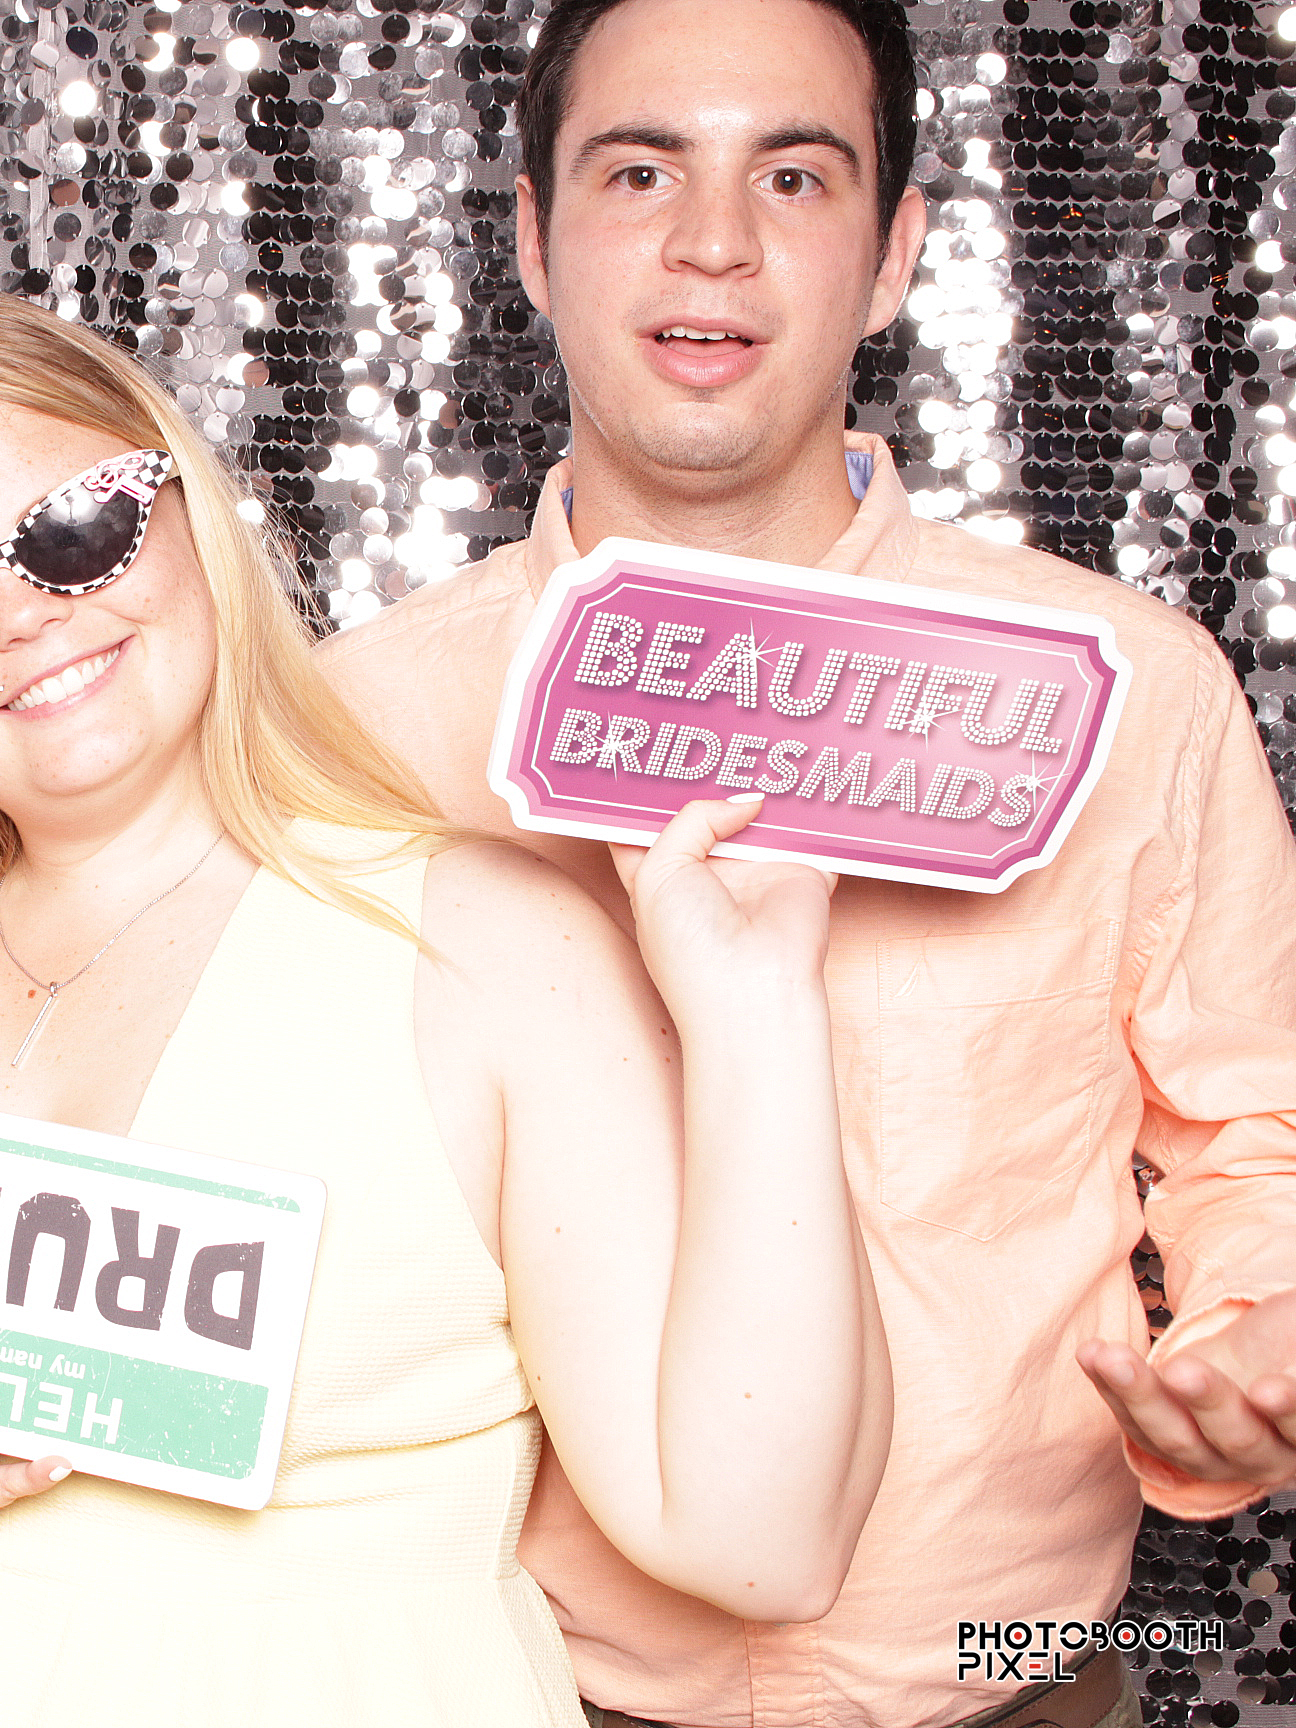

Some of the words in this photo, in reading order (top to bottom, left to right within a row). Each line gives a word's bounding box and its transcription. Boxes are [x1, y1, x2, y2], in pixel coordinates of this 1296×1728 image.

[574, 611, 1065, 755] BEAUTIFUL
[549, 707, 1034, 828] BRIDESMAIDS
[49, 1354, 86, 1380] my
